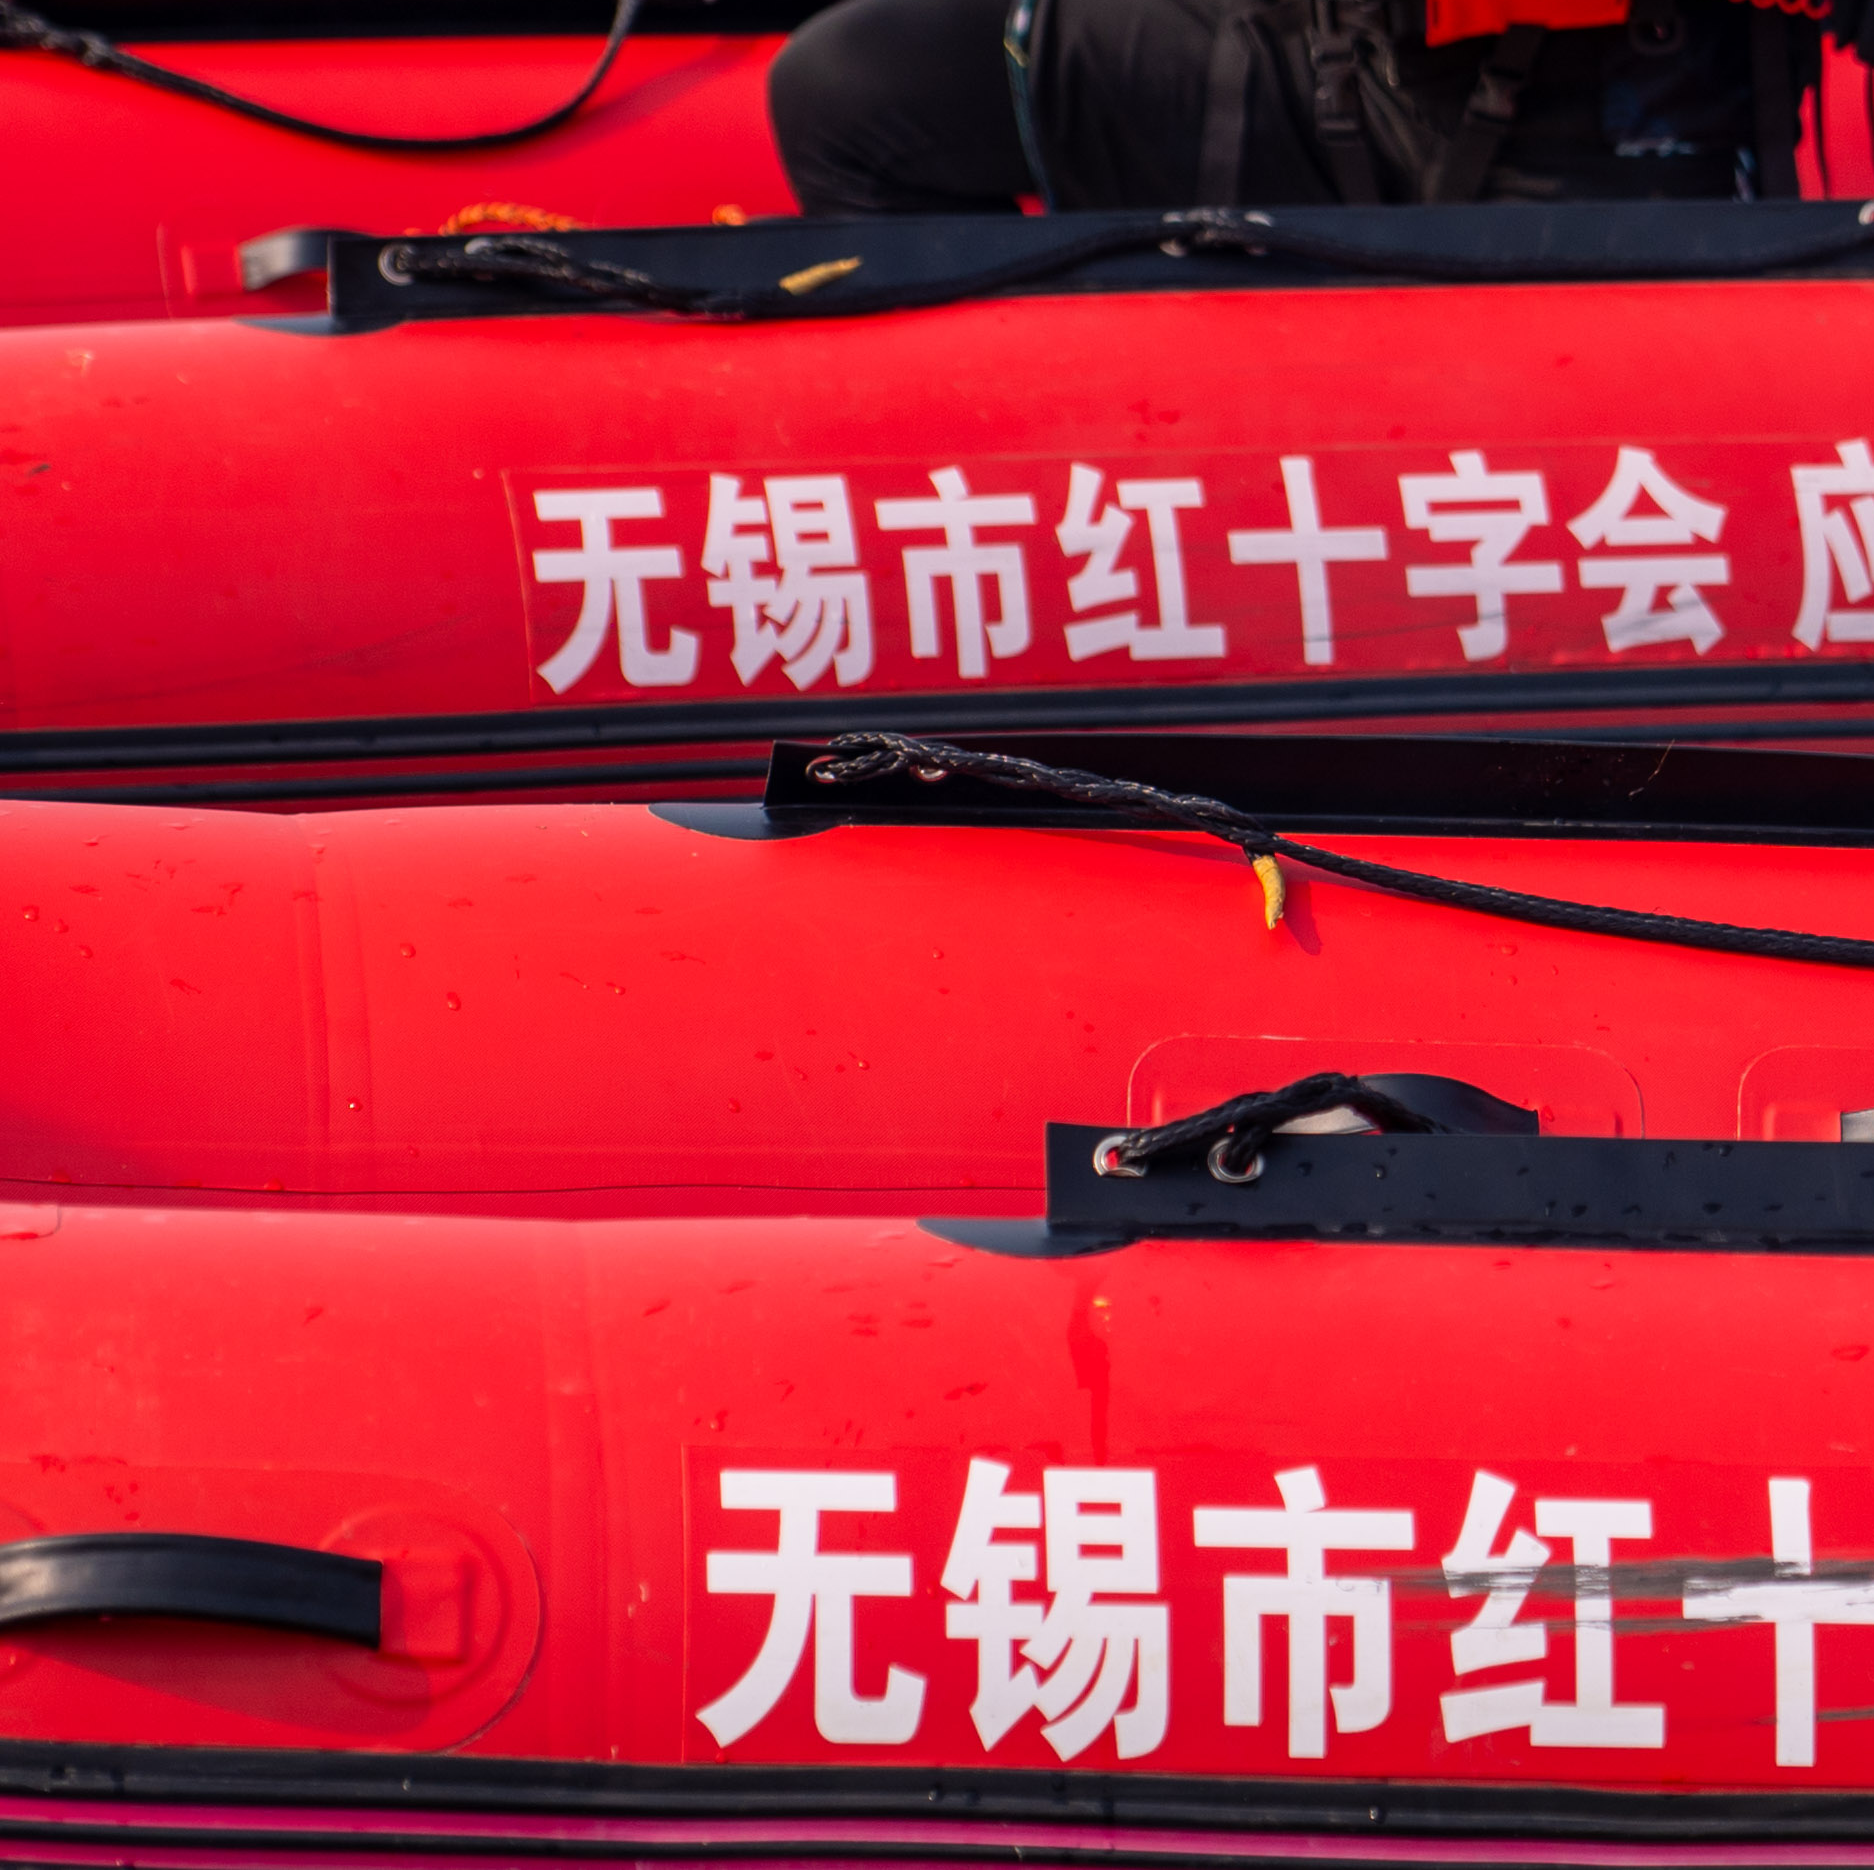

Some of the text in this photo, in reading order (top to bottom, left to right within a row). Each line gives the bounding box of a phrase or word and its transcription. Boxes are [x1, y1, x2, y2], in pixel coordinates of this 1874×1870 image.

[532, 445, 1730, 694] 无锡市红十字会
